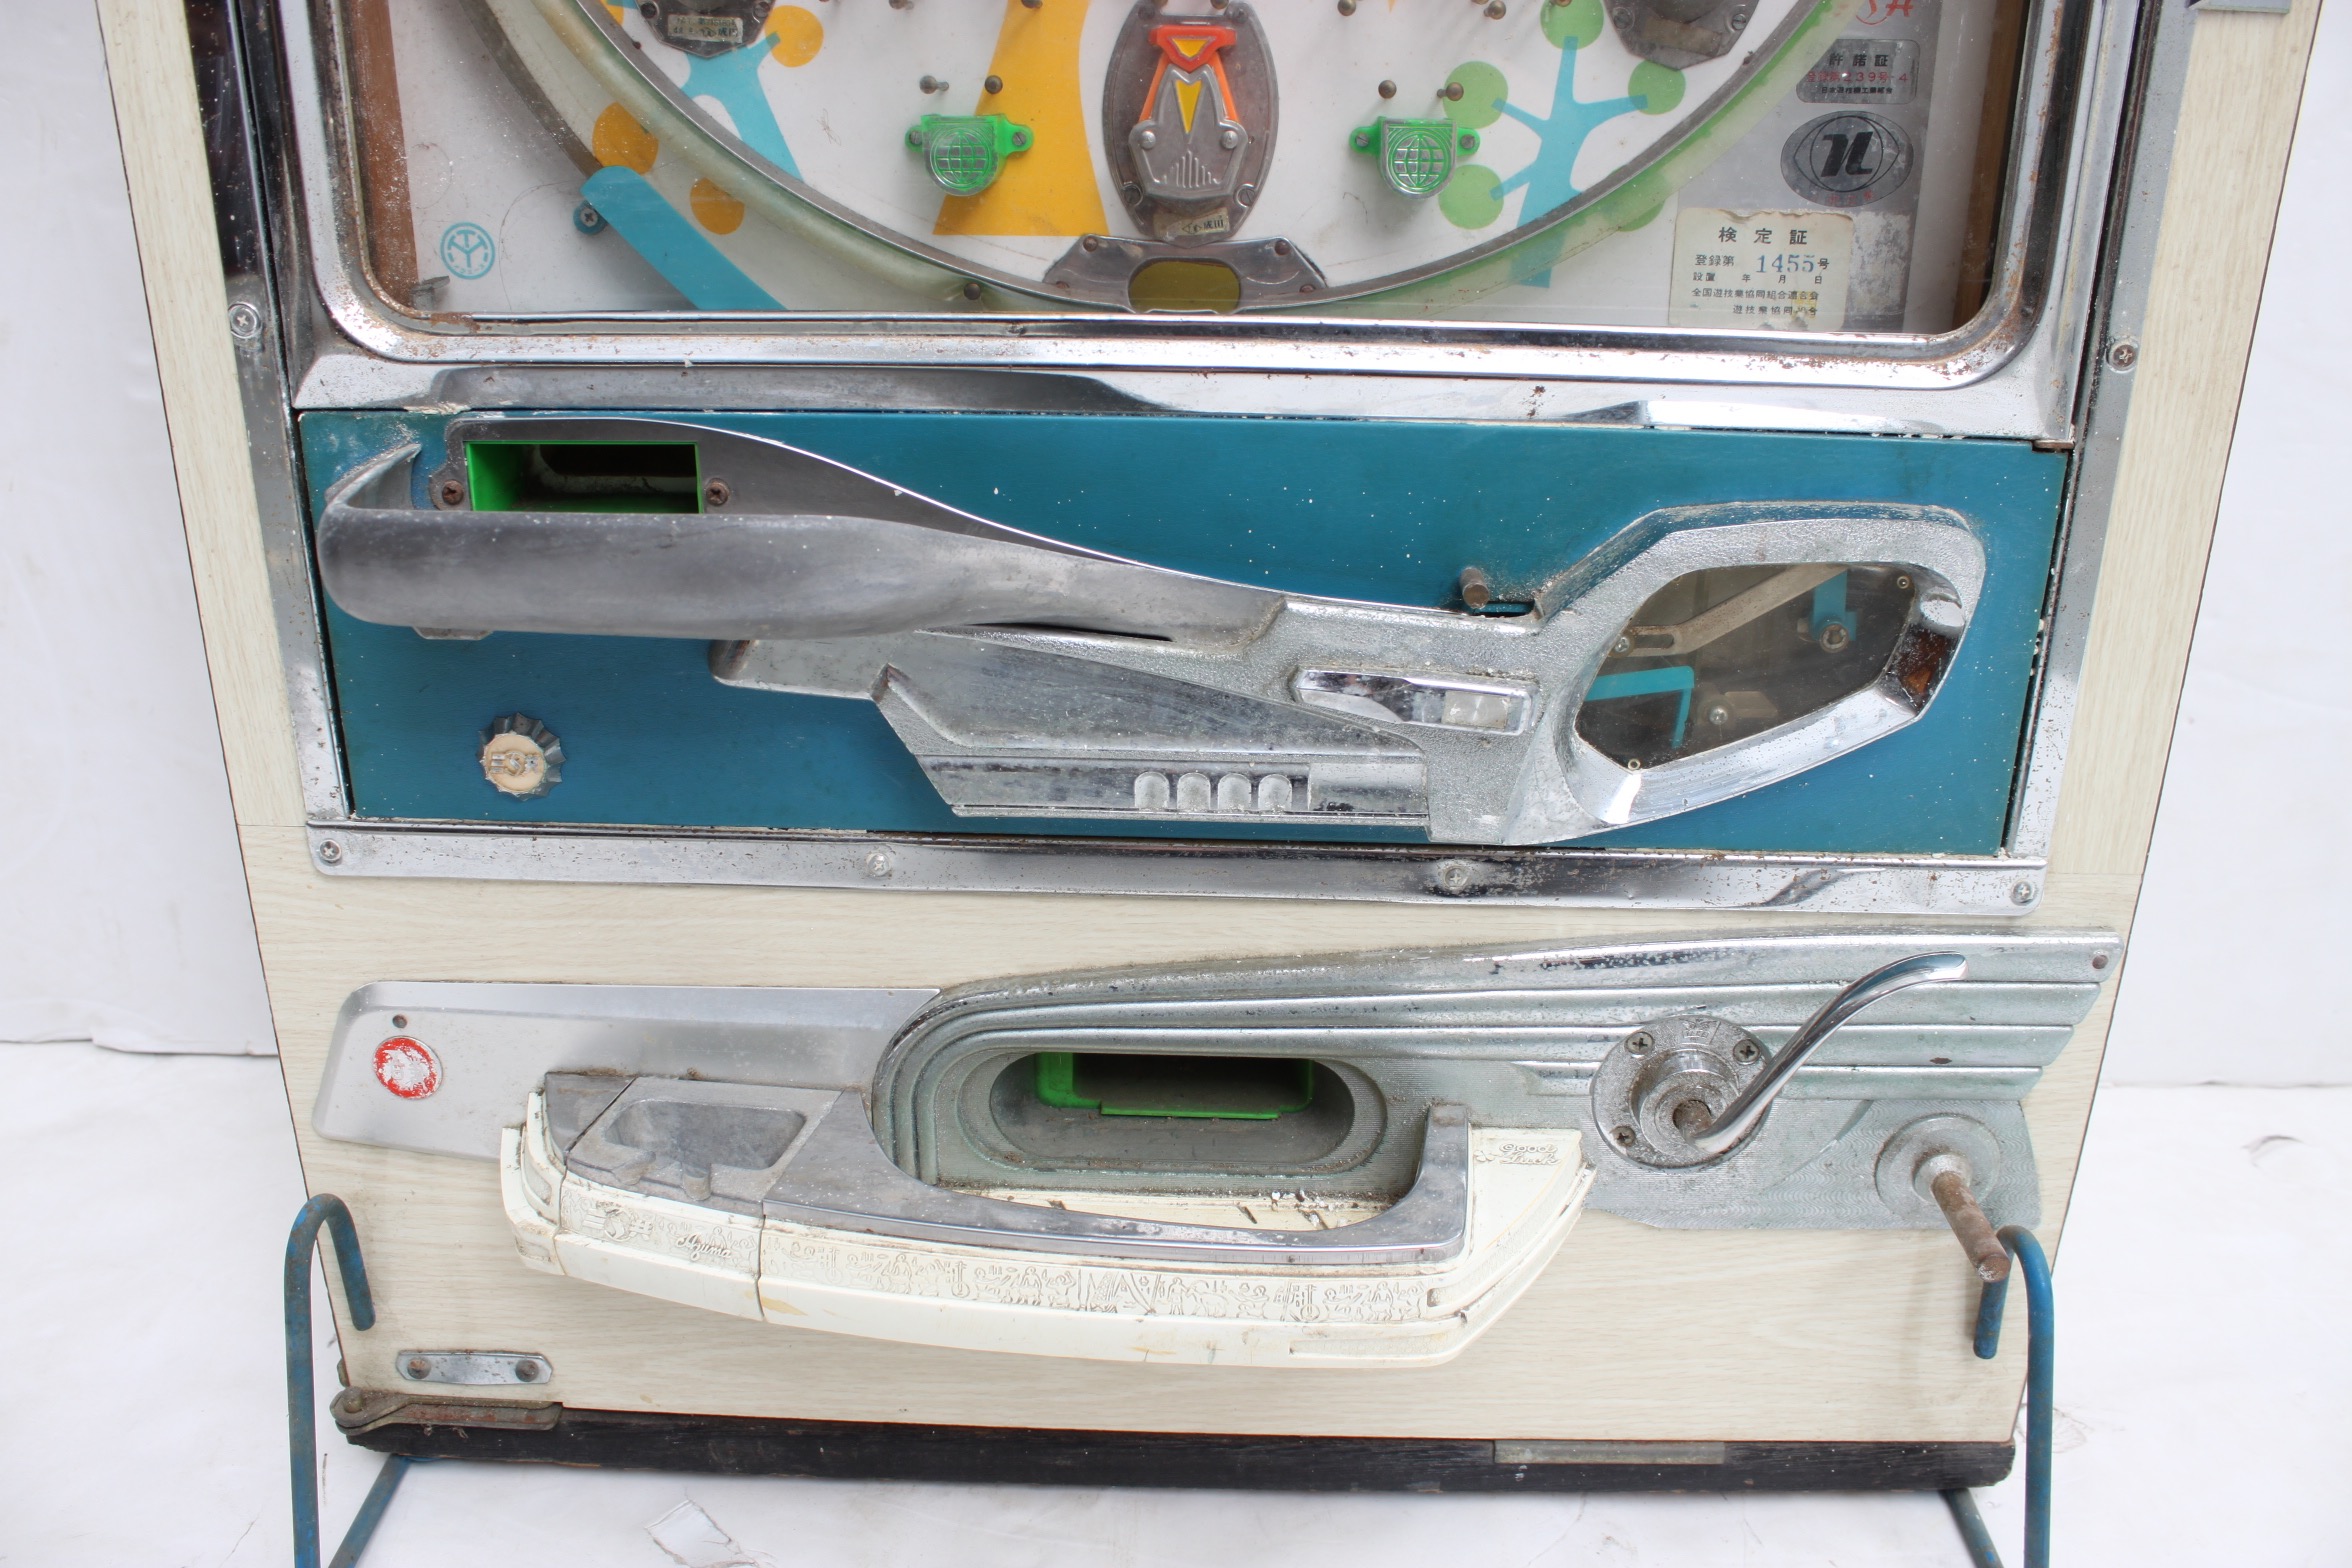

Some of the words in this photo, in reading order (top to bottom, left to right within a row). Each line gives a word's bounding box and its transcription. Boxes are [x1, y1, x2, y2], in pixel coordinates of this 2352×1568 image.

[1717, 226, 1808, 246] 検定証
[1695, 253, 1735, 267] 登録第
[1756, 254, 1816, 274] 1455
[1817, 257, 1830, 271] 号
[1742, 273, 1751, 283] 年
[1777, 274, 1787, 284] 月
[1814, 275, 1823, 285] 日
[1499, 1143, 1558, 1153] Good
[1499, 1151, 1562, 1165] Luck
